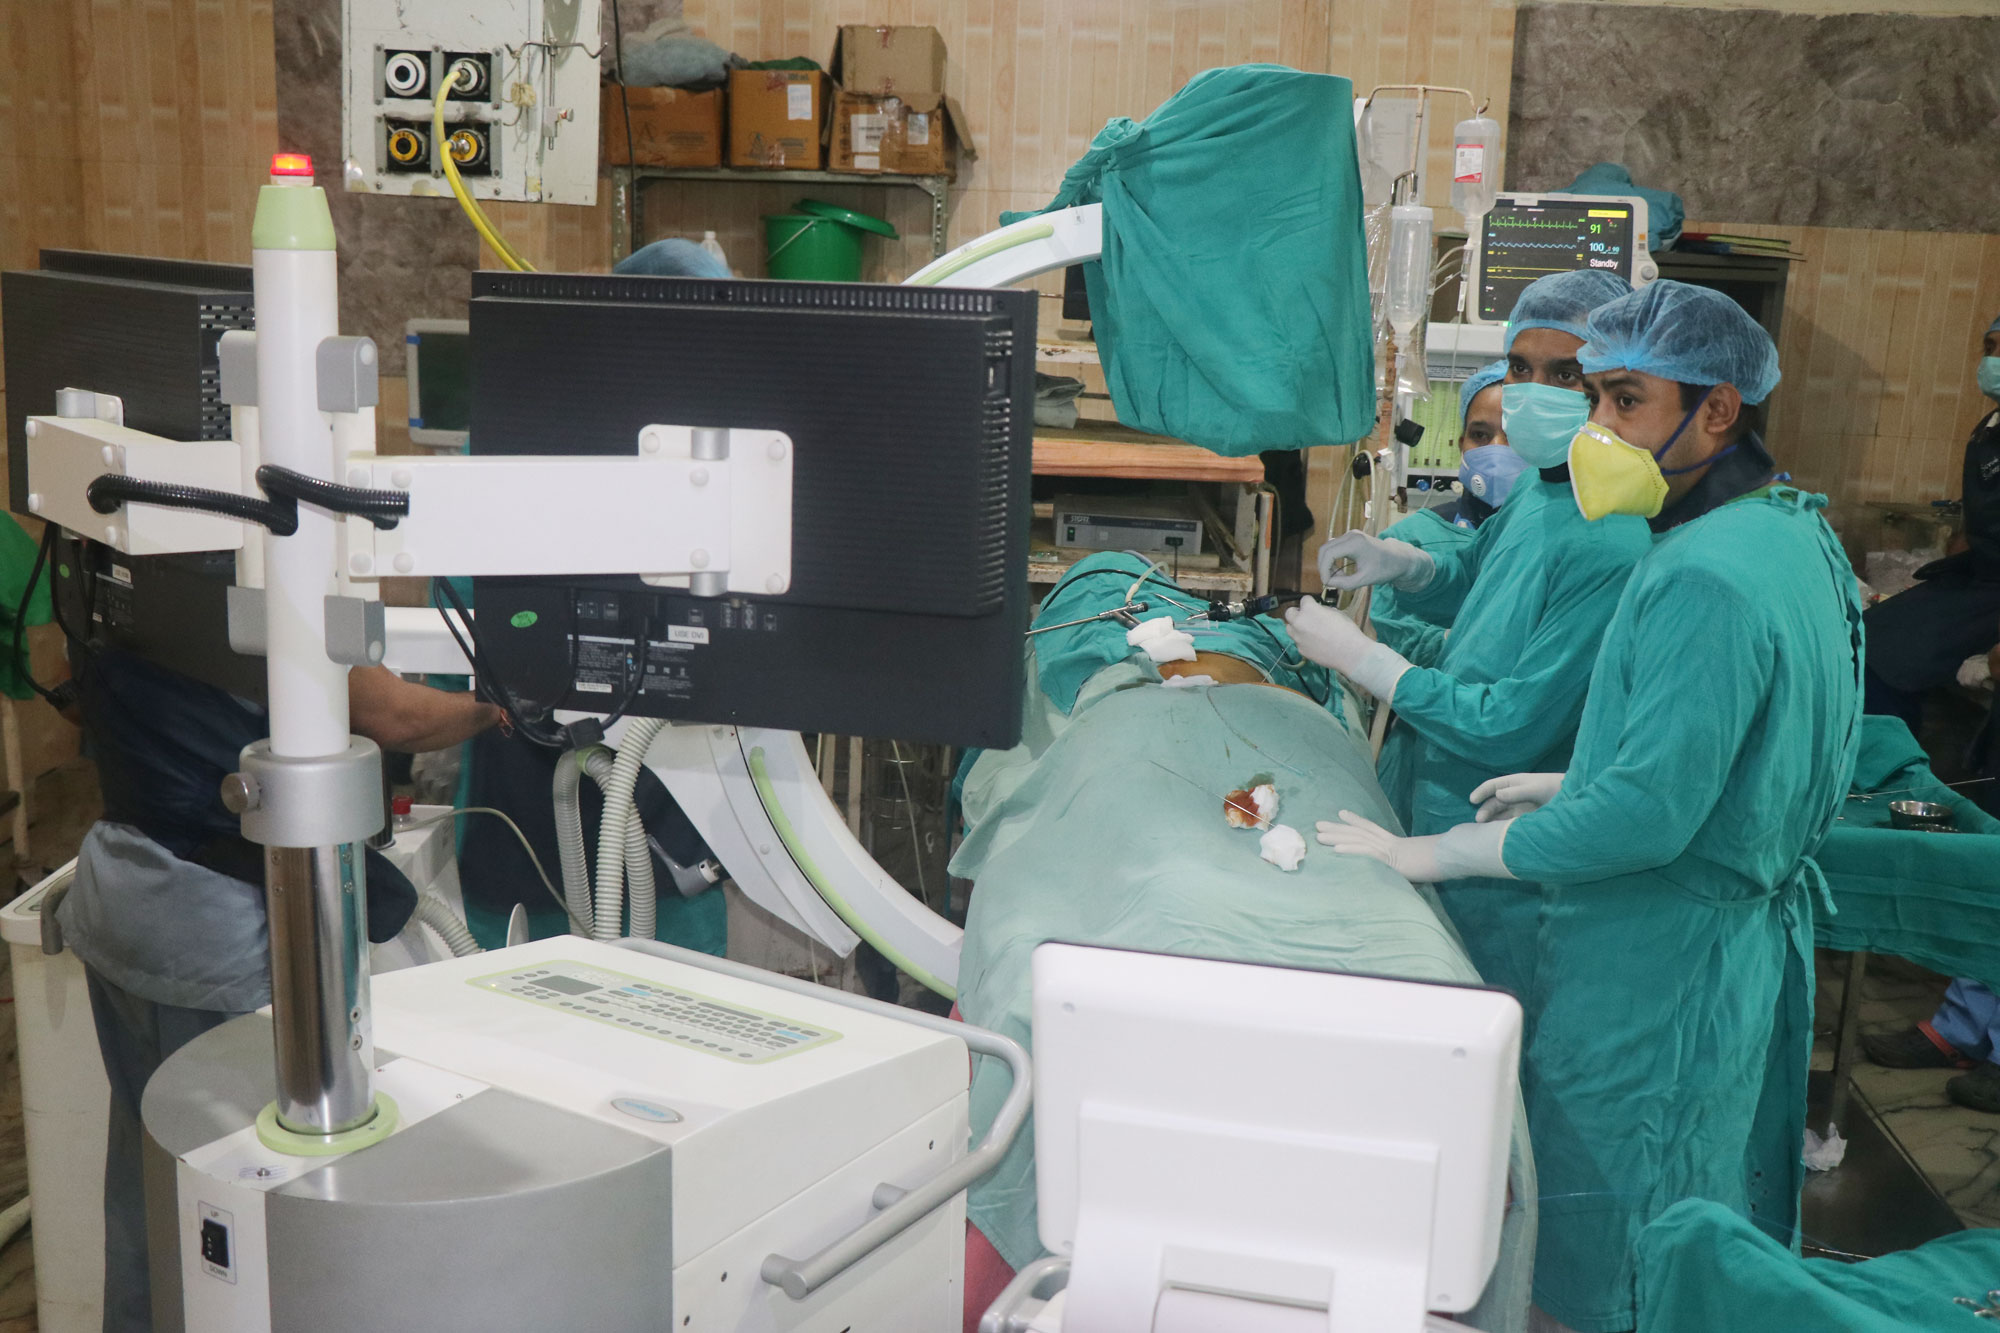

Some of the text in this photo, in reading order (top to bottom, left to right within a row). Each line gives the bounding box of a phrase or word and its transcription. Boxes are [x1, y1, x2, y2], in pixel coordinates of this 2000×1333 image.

[1590, 224, 1601, 234] 91
[1589, 243, 1604, 252] 100
[1590, 258, 1618, 270] Standby
[691, 631, 704, 640] DVI
[209, 1264, 228, 1278] DOWN
